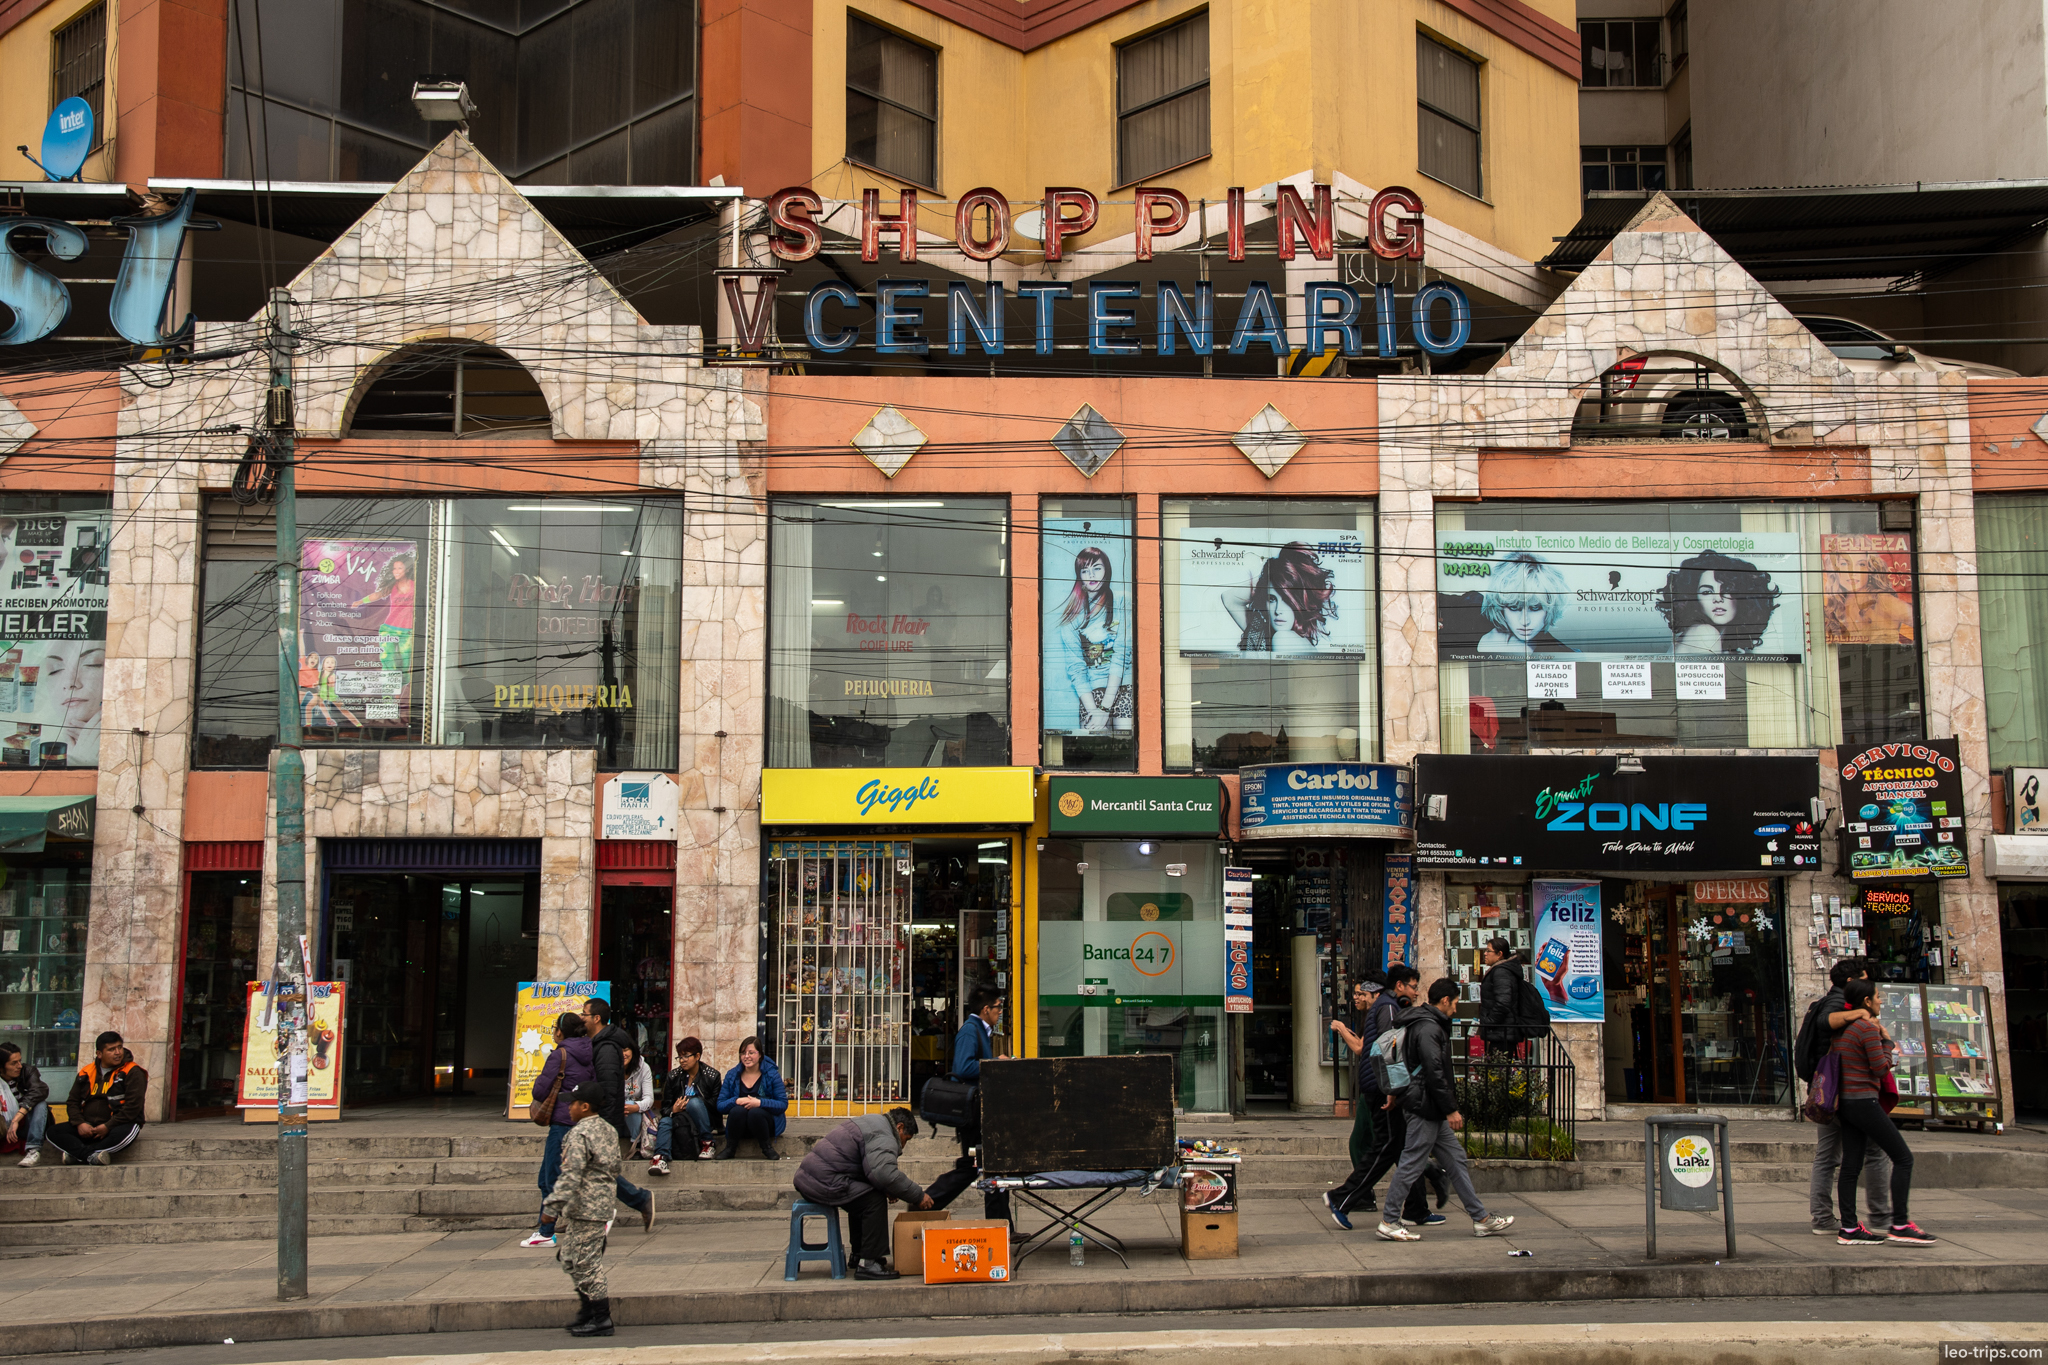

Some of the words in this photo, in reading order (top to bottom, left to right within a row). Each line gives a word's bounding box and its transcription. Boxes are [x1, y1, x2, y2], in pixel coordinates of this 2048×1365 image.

[59, 110, 84, 130] inter
[768, 185, 1425, 263] SHOPPING
[712, 267, 794, 367] V
[804, 278, 1470, 358] CENTENARIO
[1443, 541, 1495, 557] KACHA
[1495, 535, 1532, 549] Instuto
[1534, 535, 1575, 549] Tecnico
[1578, 536, 1612, 549] Medio
[1614, 536, 1628, 549] de
[1631, 537, 1670, 550] Belleza
[1673, 540, 1680, 552] y
[1683, 536, 1755, 552] Cosmetologia
[1823, 536, 1908, 551] BELLEZA
[1191, 549, 1246, 561] Schwarzkopf
[346, 552, 377, 583] Vip
[1443, 562, 1491, 577] WARA
[311, 574, 341, 584] ZUMBA
[316, 591, 342, 599] Folklore
[507, 573, 573, 609] Rock
[1576, 588, 1655, 605] Schwarzkopf
[5, 599, 48, 608] RECIBEN
[338, 611, 362, 619] Terapia
[537, 616, 622, 635] COIFFURE
[846, 612, 888, 635] Rock
[891, 614, 931, 636] Hair
[323, 634, 353, 643] Clases
[354, 634, 400, 644] especiales
[336, 645, 359, 654] para
[360, 644, 384, 653] niños
[844, 680, 934, 699] PELUQUERIA
[1544, 688, 1558, 697] 2X1
[493, 684, 633, 715] PELUQUERIA
[1841, 743, 1955, 780] SERVICIO
[1287, 769, 1379, 791] Carbol
[1862, 766, 1935, 781] TÉCNICO
[1244, 783, 1263, 791] EPSON
[1862, 779, 1939, 792] AUTORIZADO
[856, 775, 940, 817] Giggli
[1535, 772, 1600, 820] Smart
[1876, 789, 1927, 800] LIANCEL
[1090, 799, 1147, 812] Mercantil
[1149, 799, 1184, 812] Santa
[1185, 800, 1213, 812] Cruz
[1546, 802, 1708, 832] ZONE
[1602, 840, 1624, 854] Todo
[1625, 841, 1652, 855] Para
[1651, 841, 1663, 851] tu
[898, 860, 908, 870] 34
[1416, 856, 1477, 864] smartzonebolivia
[1805, 856, 1817, 864] LG
[1227, 870, 1251, 878] Carbol
[1853, 869, 1882, 877] FLASHEO
[1888, 867, 1929, 876] DESBLOQUEO
[1694, 880, 1769, 900] OFERTAS
[1866, 892, 1910, 903] SERVICIO
[1387, 877, 1408, 924] MAYOR
[1544, 892, 1585, 904] carguita
[1550, 902, 1595, 922] feliz
[1083, 944, 1130, 960] Banca
[1135, 948, 1155, 964] 24
[1160, 948, 1170, 963] 7
[1547, 944, 1565, 960] feliz
[531, 982, 561, 999] The
[563, 981, 598, 997] Best
[1571, 984, 1591, 993] entel
[1227, 996, 1252, 1004] CARTUCHOS
[1233, 1003, 1250, 1011] TONERS
[261, 1076, 269, 1085] Y
